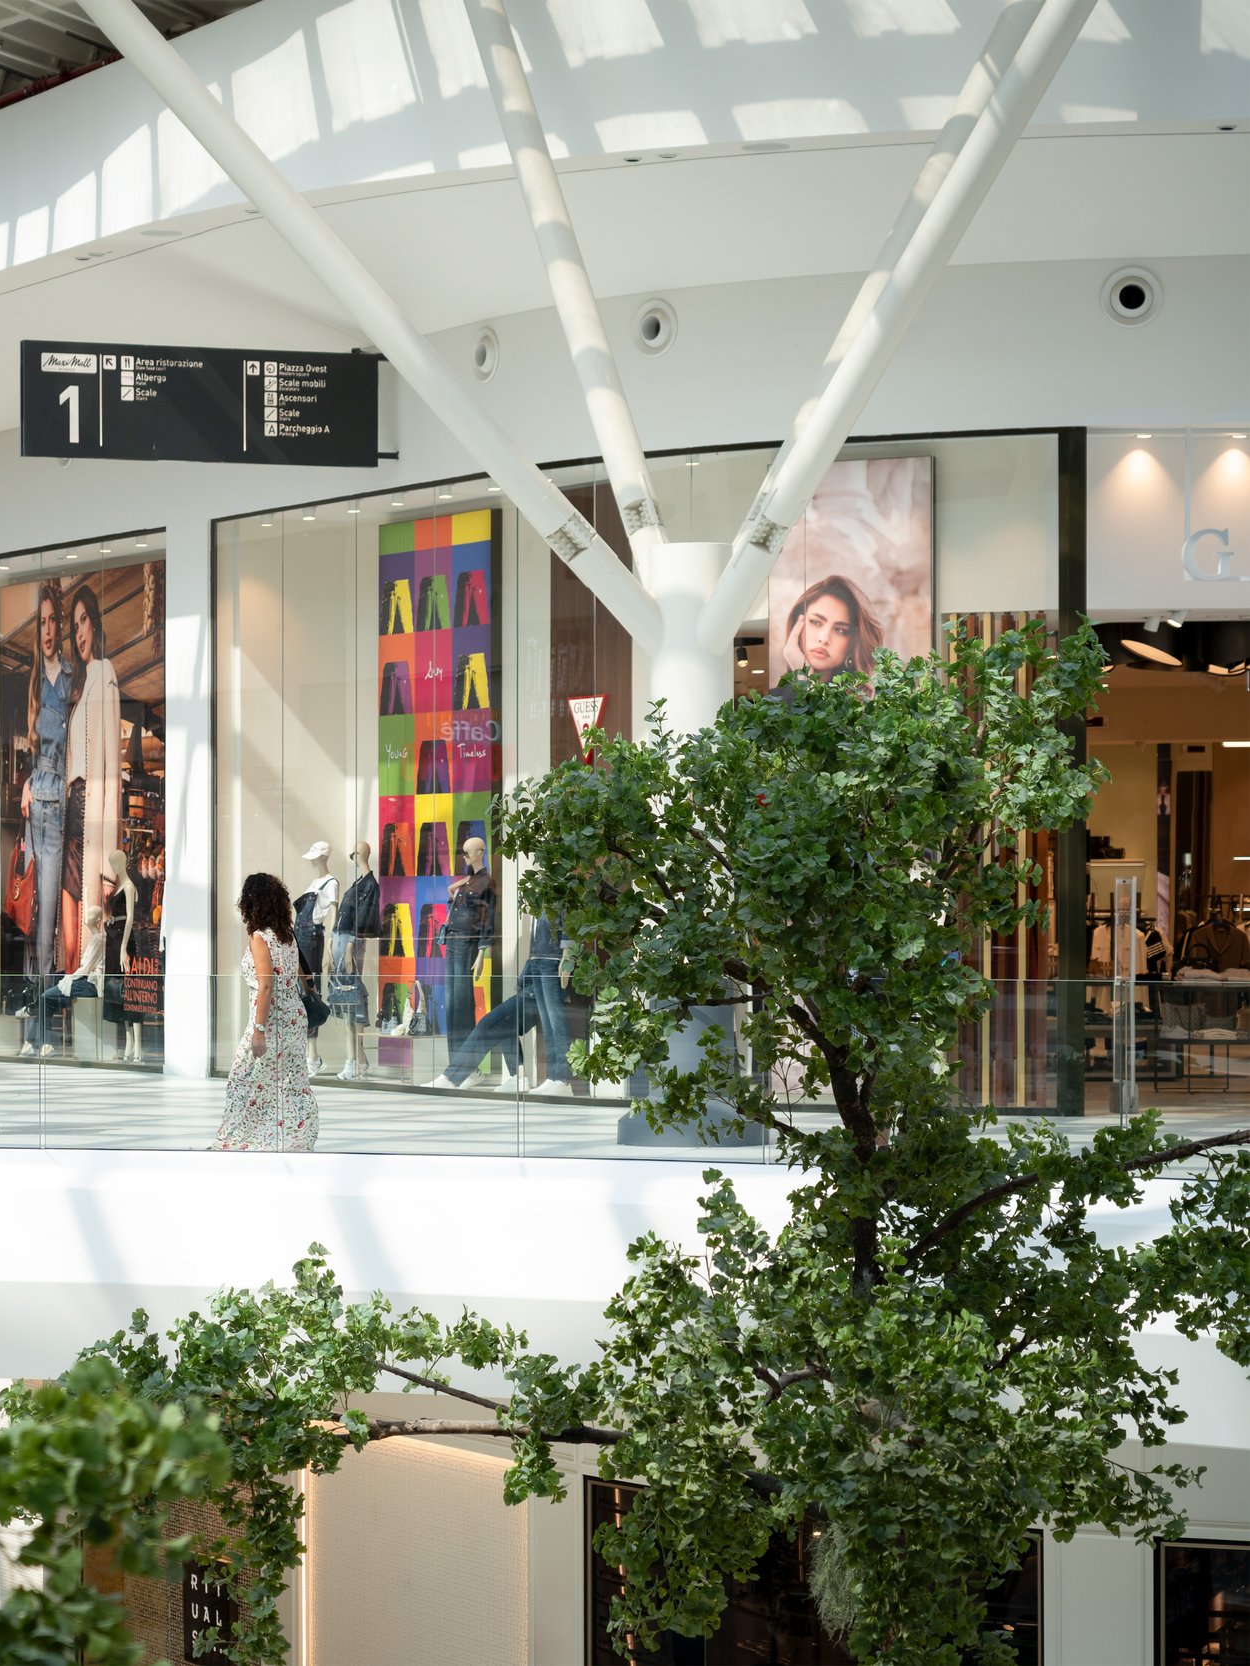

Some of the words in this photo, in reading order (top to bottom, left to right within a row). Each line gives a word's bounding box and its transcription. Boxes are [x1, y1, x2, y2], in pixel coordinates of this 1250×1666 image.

[135, 357, 154, 366] Area
[156, 358, 203, 368] ristorazione
[279, 363, 304, 372] Piazza
[305, 364, 327, 373] Ovest
[135, 373, 167, 384] Albergo
[279, 378, 300, 387] Scale
[301, 379, 326, 388] mobili
[135, 388, 157, 397] Scale
[279, 393, 318, 403] Ascensori
[59, 385, 79, 443] 1
[279, 408, 300, 417] Scale
[279, 423, 323, 436] Parcheggio
[323, 425, 330, 433] A
[573, 701, 599, 714] GUESS
